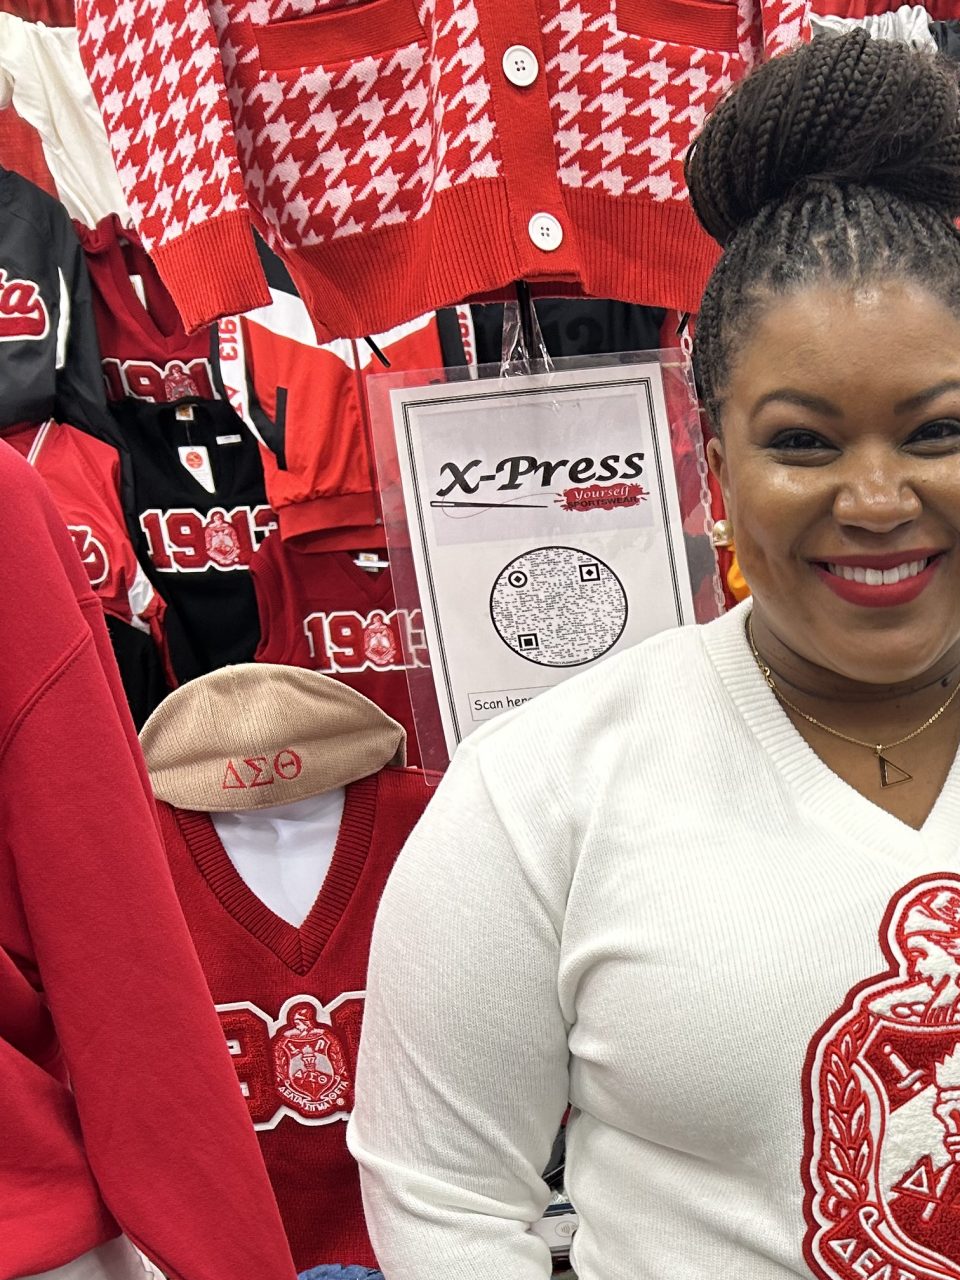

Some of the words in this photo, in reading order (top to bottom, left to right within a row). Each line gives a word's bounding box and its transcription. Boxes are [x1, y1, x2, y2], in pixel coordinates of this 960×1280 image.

[436, 453, 645, 497] X-Press
[574, 486, 629, 501] Yourself
[567, 496, 638, 509] SPORTSWEAR
[474, 699, 504, 711] Scan
[506, 696, 533, 708] her
[222, 748, 303, 789] ΔΣΘ
